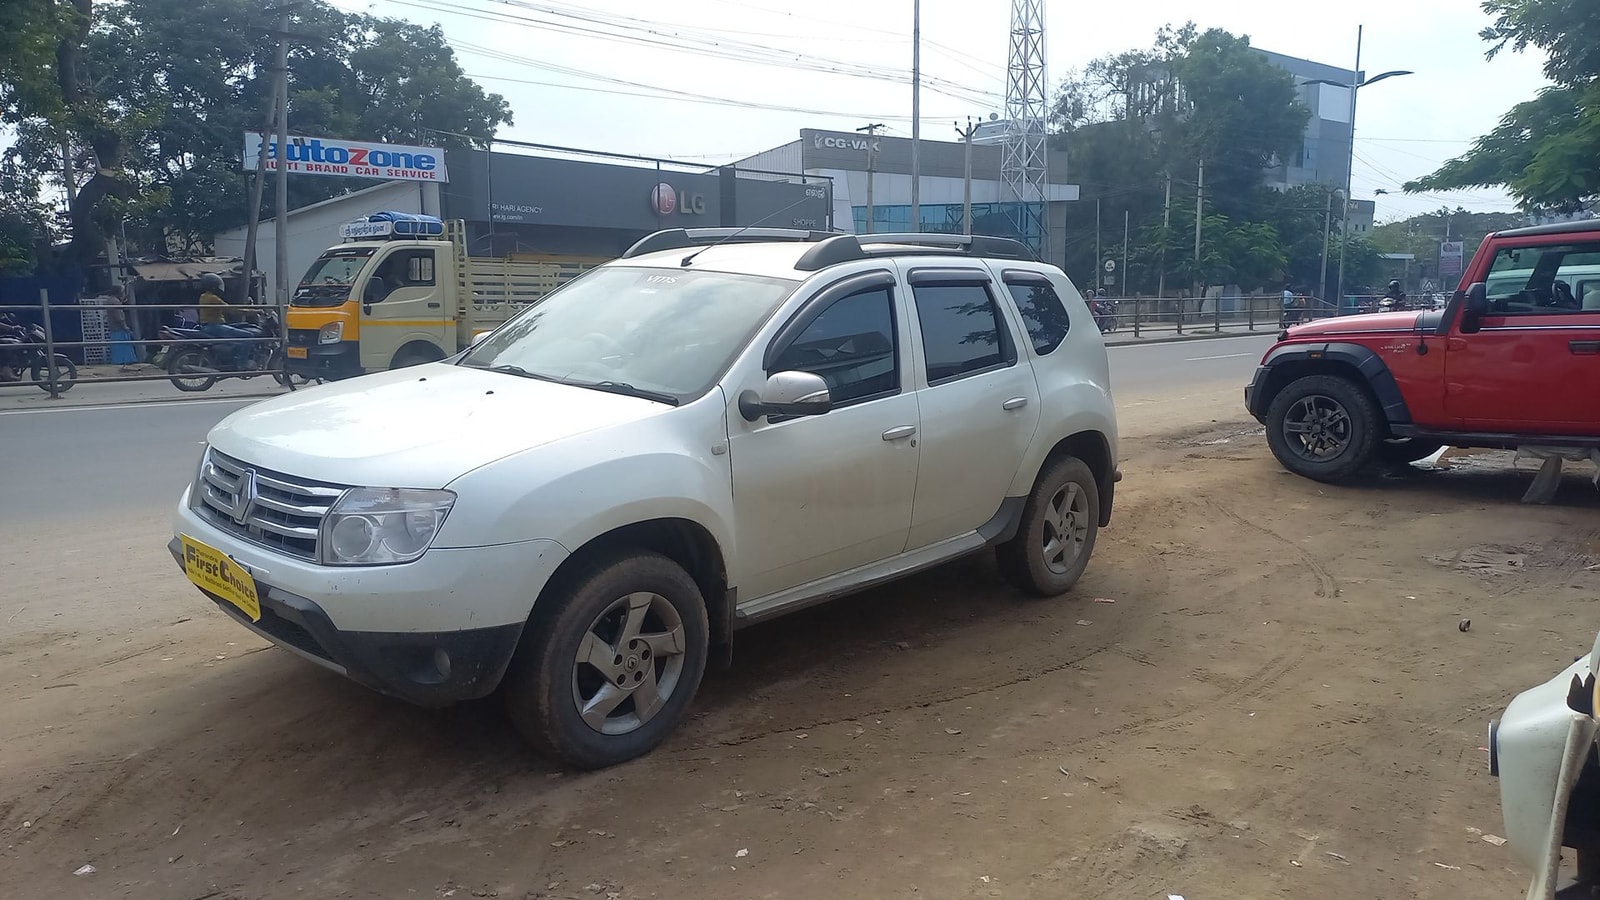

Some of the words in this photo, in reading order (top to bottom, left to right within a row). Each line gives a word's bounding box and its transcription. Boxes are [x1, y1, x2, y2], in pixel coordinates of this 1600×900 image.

[306, 163, 348, 174] BRAND
[355, 167, 380, 176] CAR
[387, 168, 436, 179] SERVICE
[500, 204, 516, 212] HARI
[516, 205, 542, 214] AGENCY
[680, 190, 706, 215] LG
[792, 218, 817, 227] SHOPPE
[185, 543, 219, 578] First
[220, 560, 256, 603] Choice
